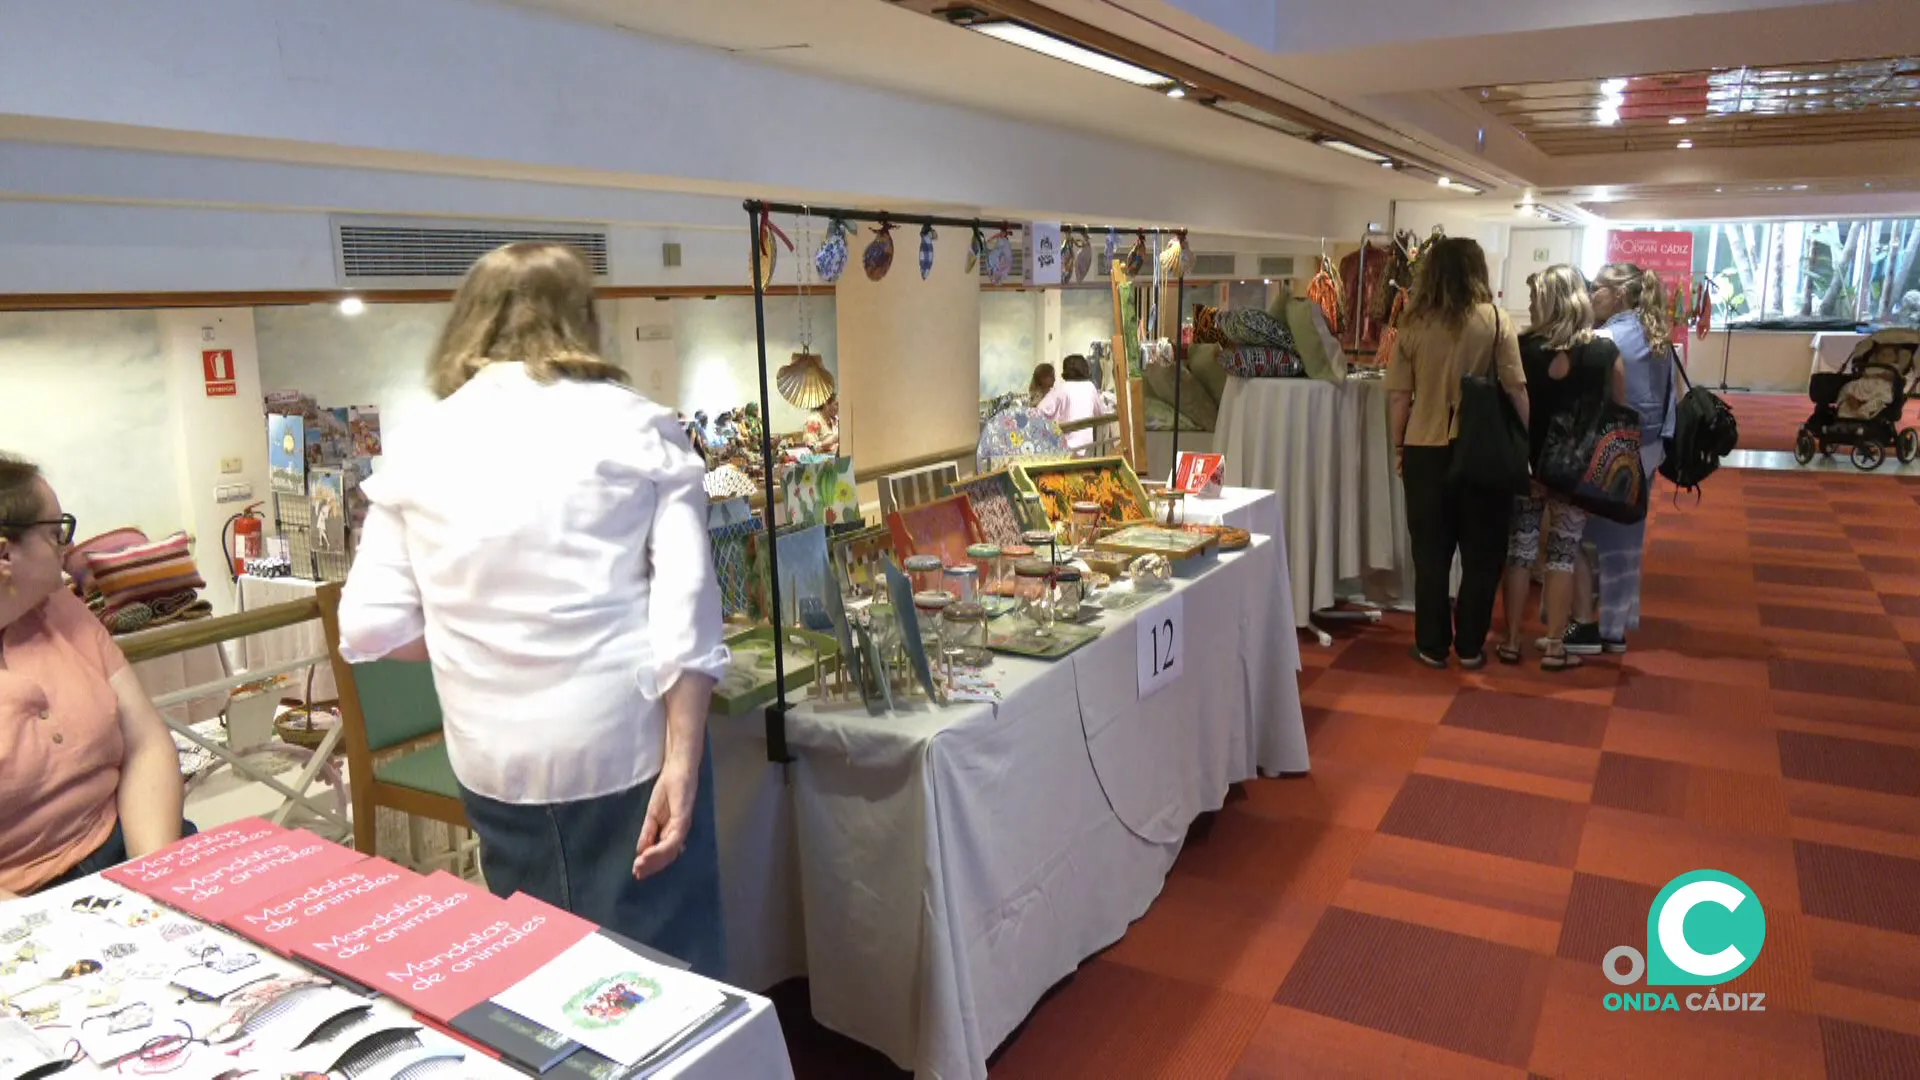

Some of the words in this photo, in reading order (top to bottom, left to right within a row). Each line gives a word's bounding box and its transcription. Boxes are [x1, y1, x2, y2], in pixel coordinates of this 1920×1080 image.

[1660, 241, 1688, 254] CÁDIZ
[1151, 618, 1175, 676] 12
[124, 829, 240, 876] Mandalas
[142, 868, 173, 882] de
[179, 829, 273, 867] animales
[172, 844, 290, 894] Mandalas
[192, 885, 224, 901] de
[229, 844, 324, 885] animales
[244, 872, 365, 924] Mandalas
[265, 916, 299, 933] de
[303, 872, 399, 916] animales
[312, 893, 432, 951] Mandalas
[337, 941, 371, 959] de
[375, 893, 468, 943] animales
[386, 920, 509, 982] Mandalas
[412, 972, 446, 991] de
[451, 915, 546, 973] animales
